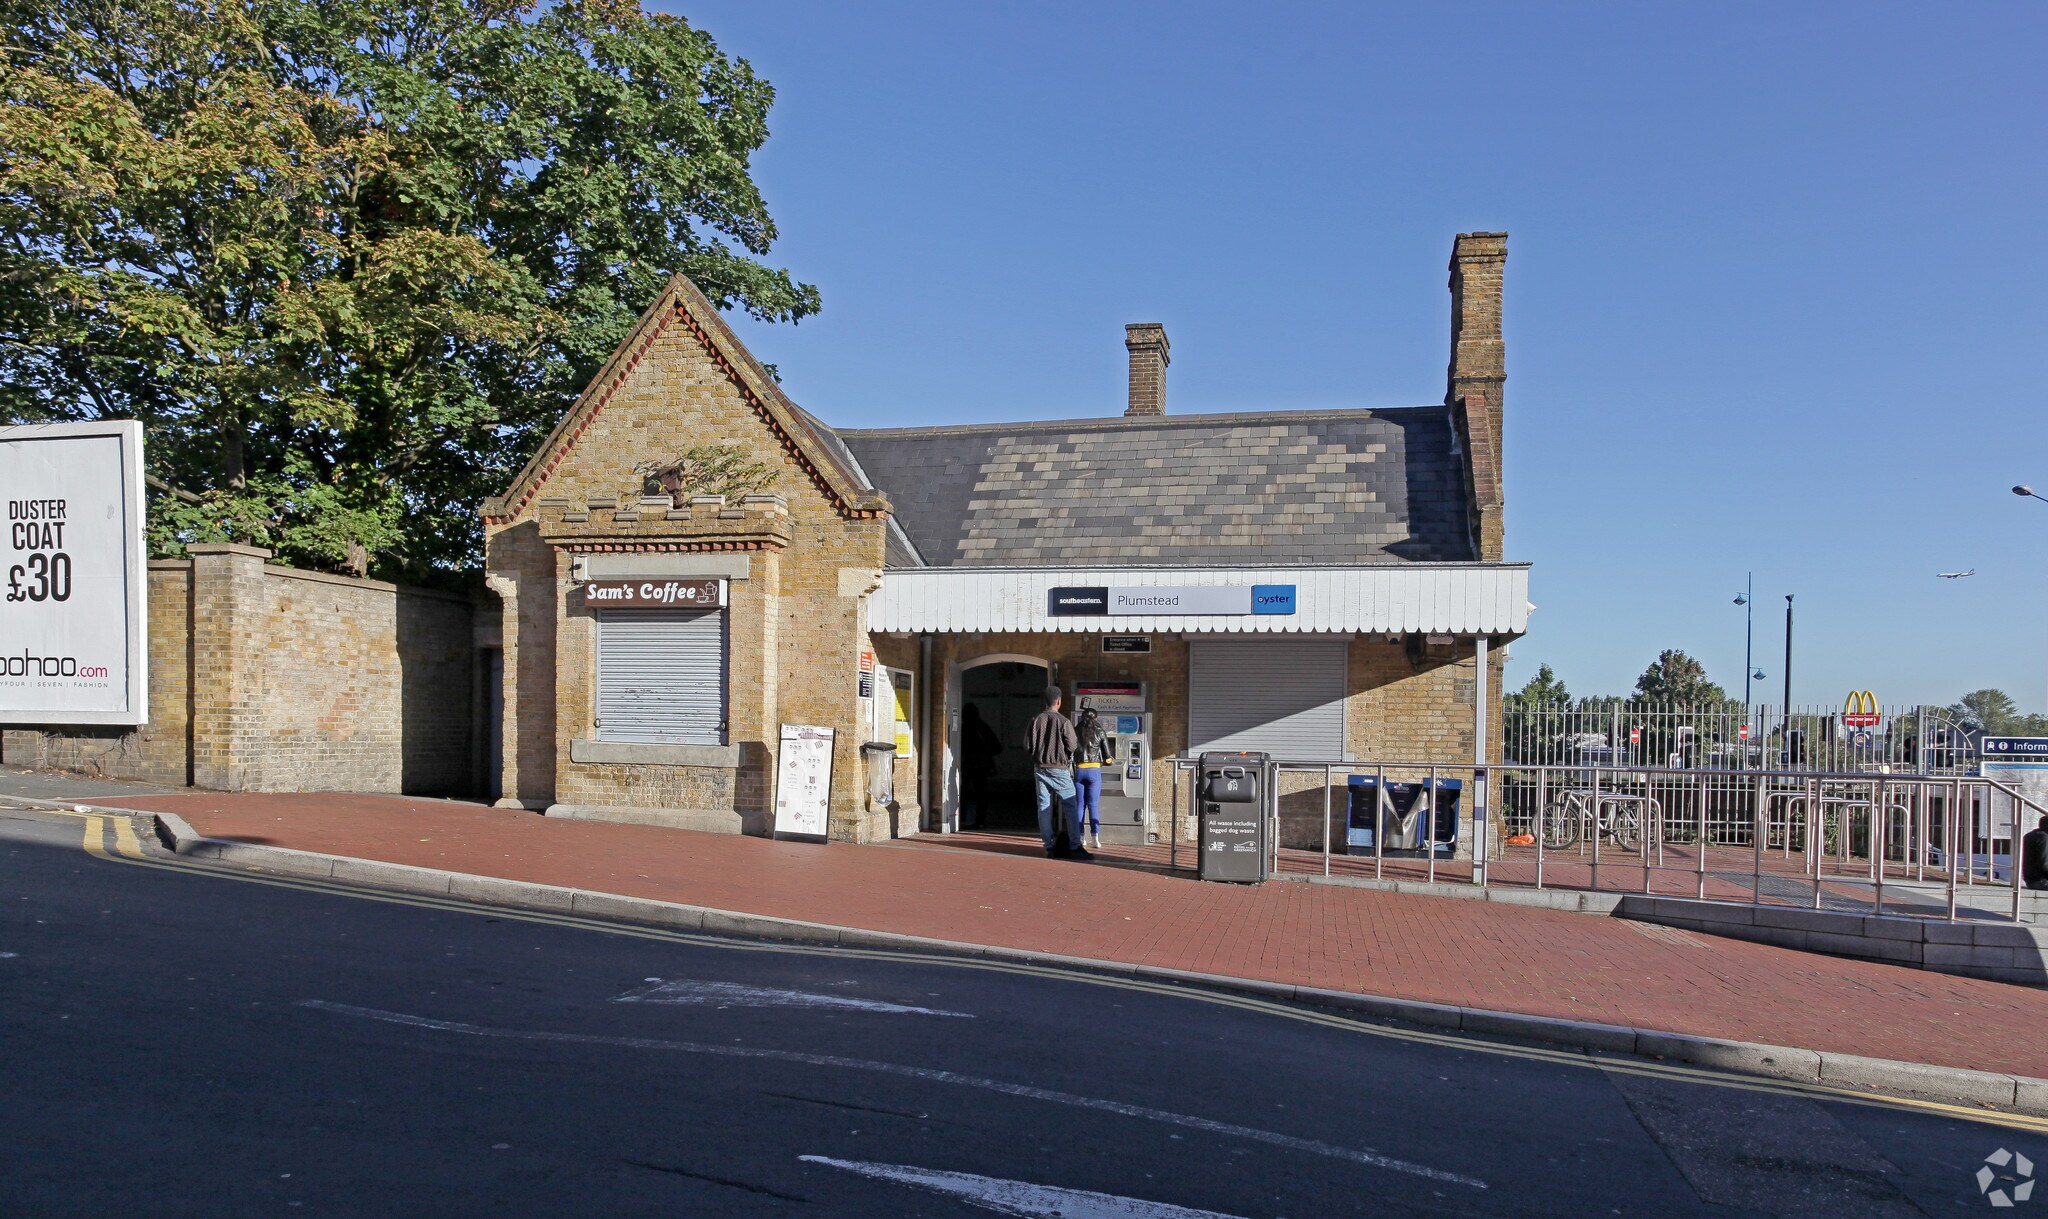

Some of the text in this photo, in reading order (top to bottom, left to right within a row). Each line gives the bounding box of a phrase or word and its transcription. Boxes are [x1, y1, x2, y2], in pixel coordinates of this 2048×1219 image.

[9, 499, 66, 520] DUSTER
[12, 521, 65, 550] COAT
[7, 552, 71, 602] £30
[587, 582, 696, 603] Sam's Coffee
[1118, 595, 1179, 606] Plumstead
[1257, 594, 1290, 606] oyster
[2013, 742, 2048, 750] Inform
